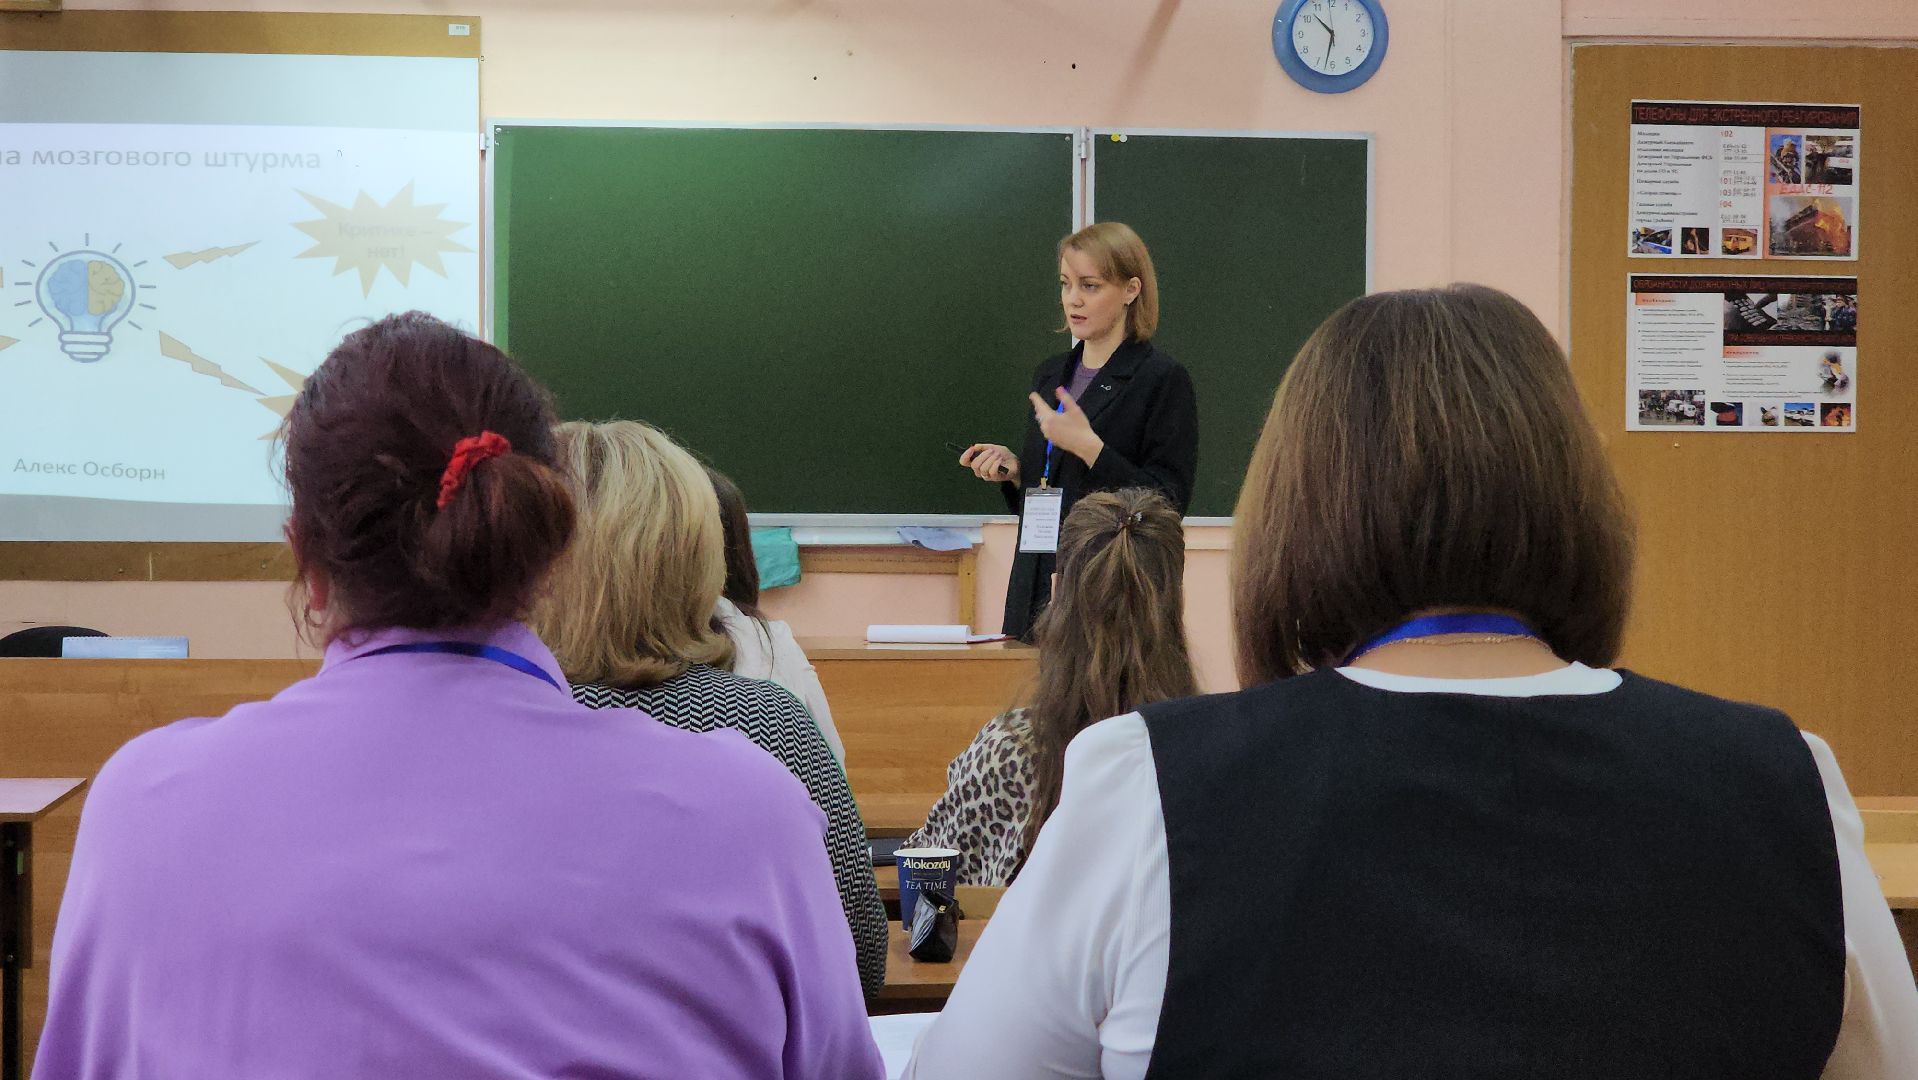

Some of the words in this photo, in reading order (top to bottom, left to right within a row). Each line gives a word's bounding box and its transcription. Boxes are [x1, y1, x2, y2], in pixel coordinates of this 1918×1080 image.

[1303, 15, 1312, 23] 10
[1355, 13, 1361, 22] 2
[1298, 31, 1304, 39] 9
[1360, 29, 1366, 37] 3
[1302, 46, 1309, 54] 8
[1329, 61, 1336, 69] 6
[1634, 107, 1686, 121] ТЕЛЕФОНЫ
[32, 150, 192, 167] мозгового
[203, 151, 321, 173] штурма
[367, 245, 405, 259] нет!
[13, 458, 77, 475] Алекс
[82, 461, 166, 482] Осборн
[903, 857, 951, 871] Alokozay
[905, 880, 921, 890] TEA
[924, 880, 947, 891] TIME
